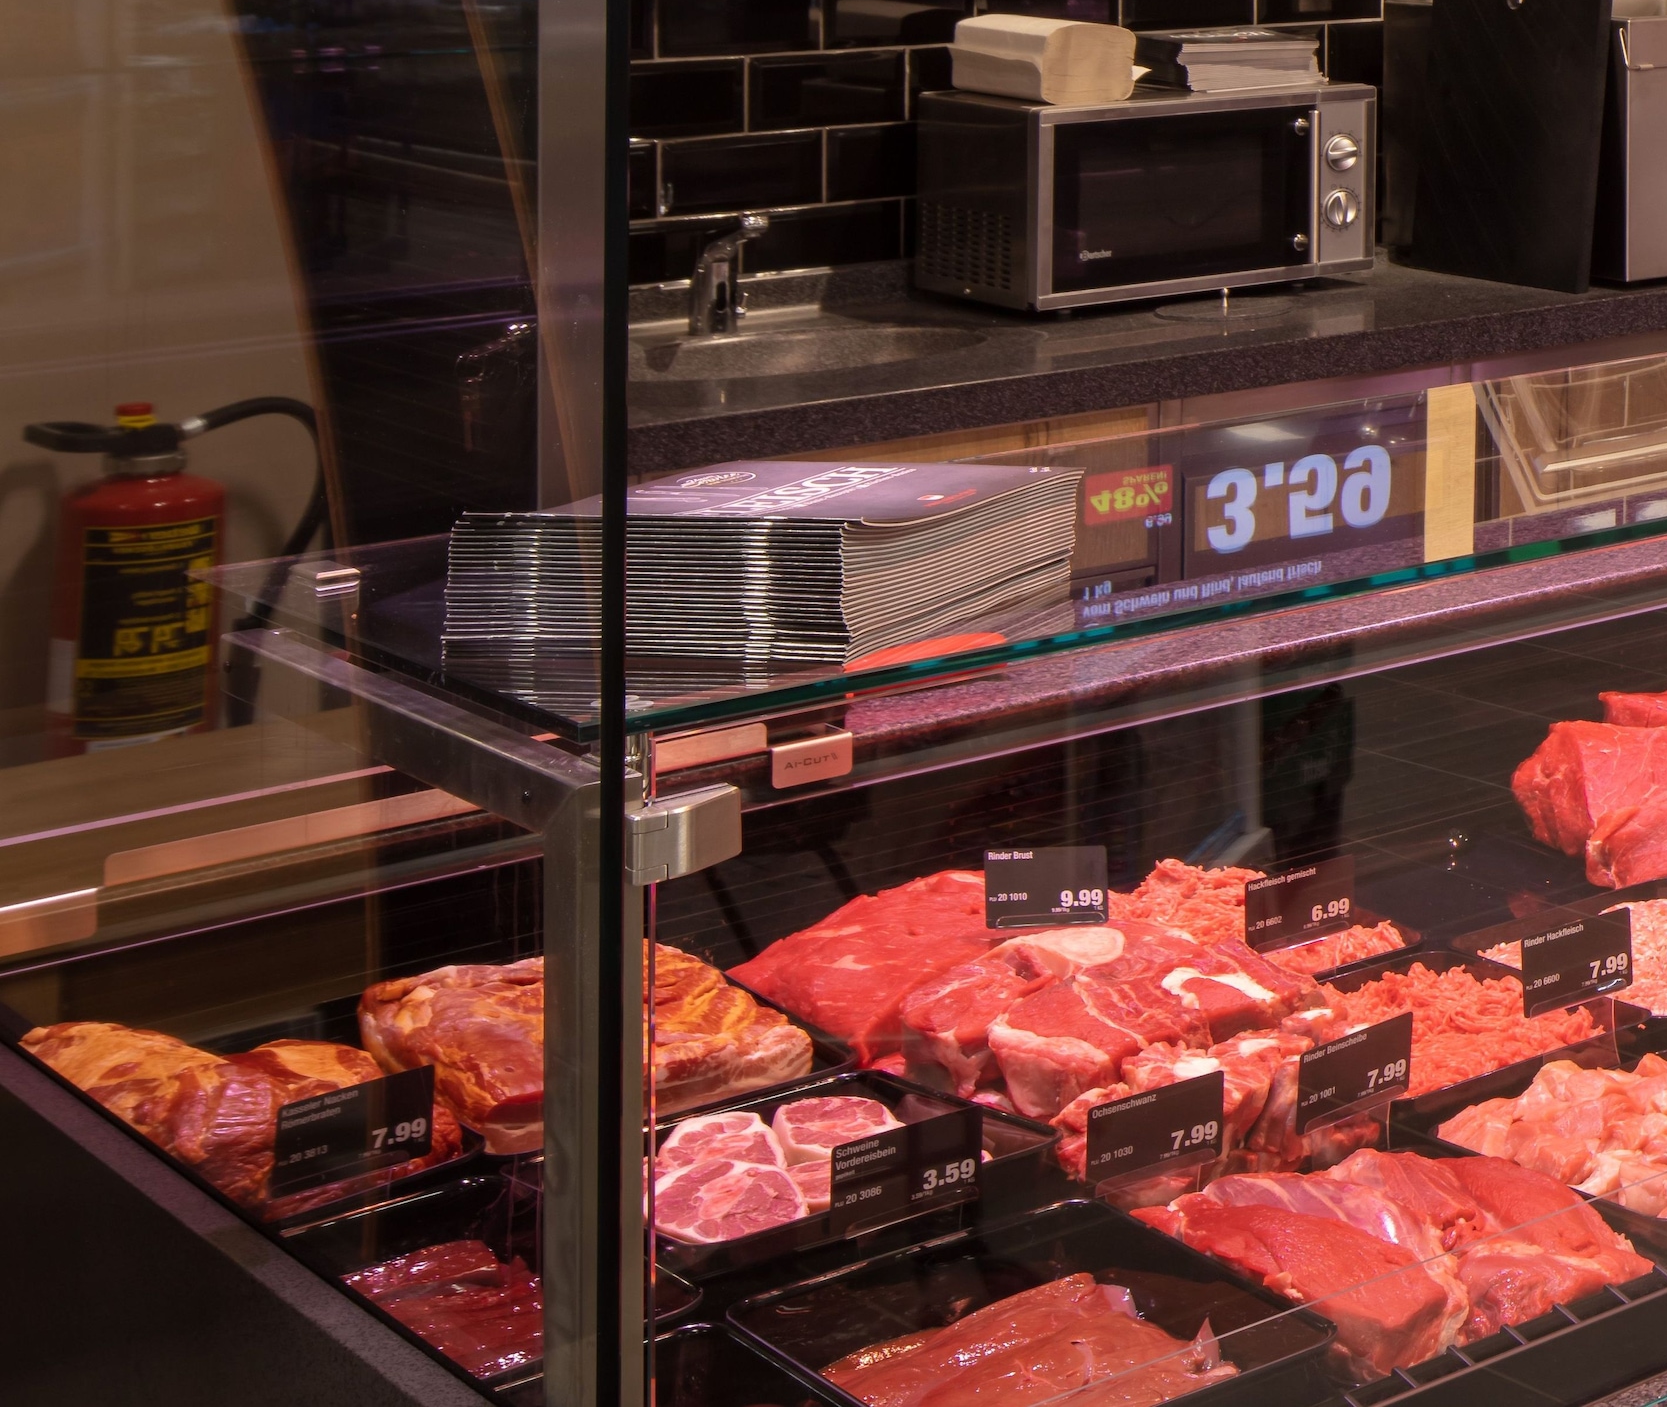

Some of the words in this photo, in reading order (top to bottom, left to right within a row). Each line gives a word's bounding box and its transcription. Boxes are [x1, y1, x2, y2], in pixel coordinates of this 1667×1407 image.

[988, 851, 1012, 860] Rinder
[1013, 851, 1033, 860] Brust
[1248, 876, 1285, 892] Hackfleisch
[1287, 867, 1317, 883] gemischt
[998, 894, 1008, 902] 20
[1008, 892, 1028, 901] 1010
[1060, 889, 1103, 907] 9.99
[1312, 897, 1350, 922] 6.99
[1524, 936, 1546, 948] Rinder
[1546, 924, 1584, 942] Hackfleisch
[1590, 953, 1628, 979] 7.99
[1303, 1047, 1326, 1064] Rinder
[1327, 1033, 1367, 1055] Beinscheibe
[1368, 1058, 1407, 1088] 7.99
[282, 1098, 322, 1118] Kasseler
[324, 1089, 359, 1105] Nacken
[1092, 1094, 1157, 1119] Ochsenschwanz
[1309, 1094, 1318, 1104] 20
[372, 1117, 427, 1149] 7.99
[1171, 1120, 1218, 1150] 7.99
[835, 1139, 880, 1159] Schweine
[835, 1146, 897, 1171] Vordereisbein
[1101, 1152, 1111, 1163] 20
[1113, 1146, 1134, 1159] 1030
[923, 1158, 976, 1190] 3.59
[845, 1194, 857, 1205] 20
[859, 1186, 882, 1201] 3086
